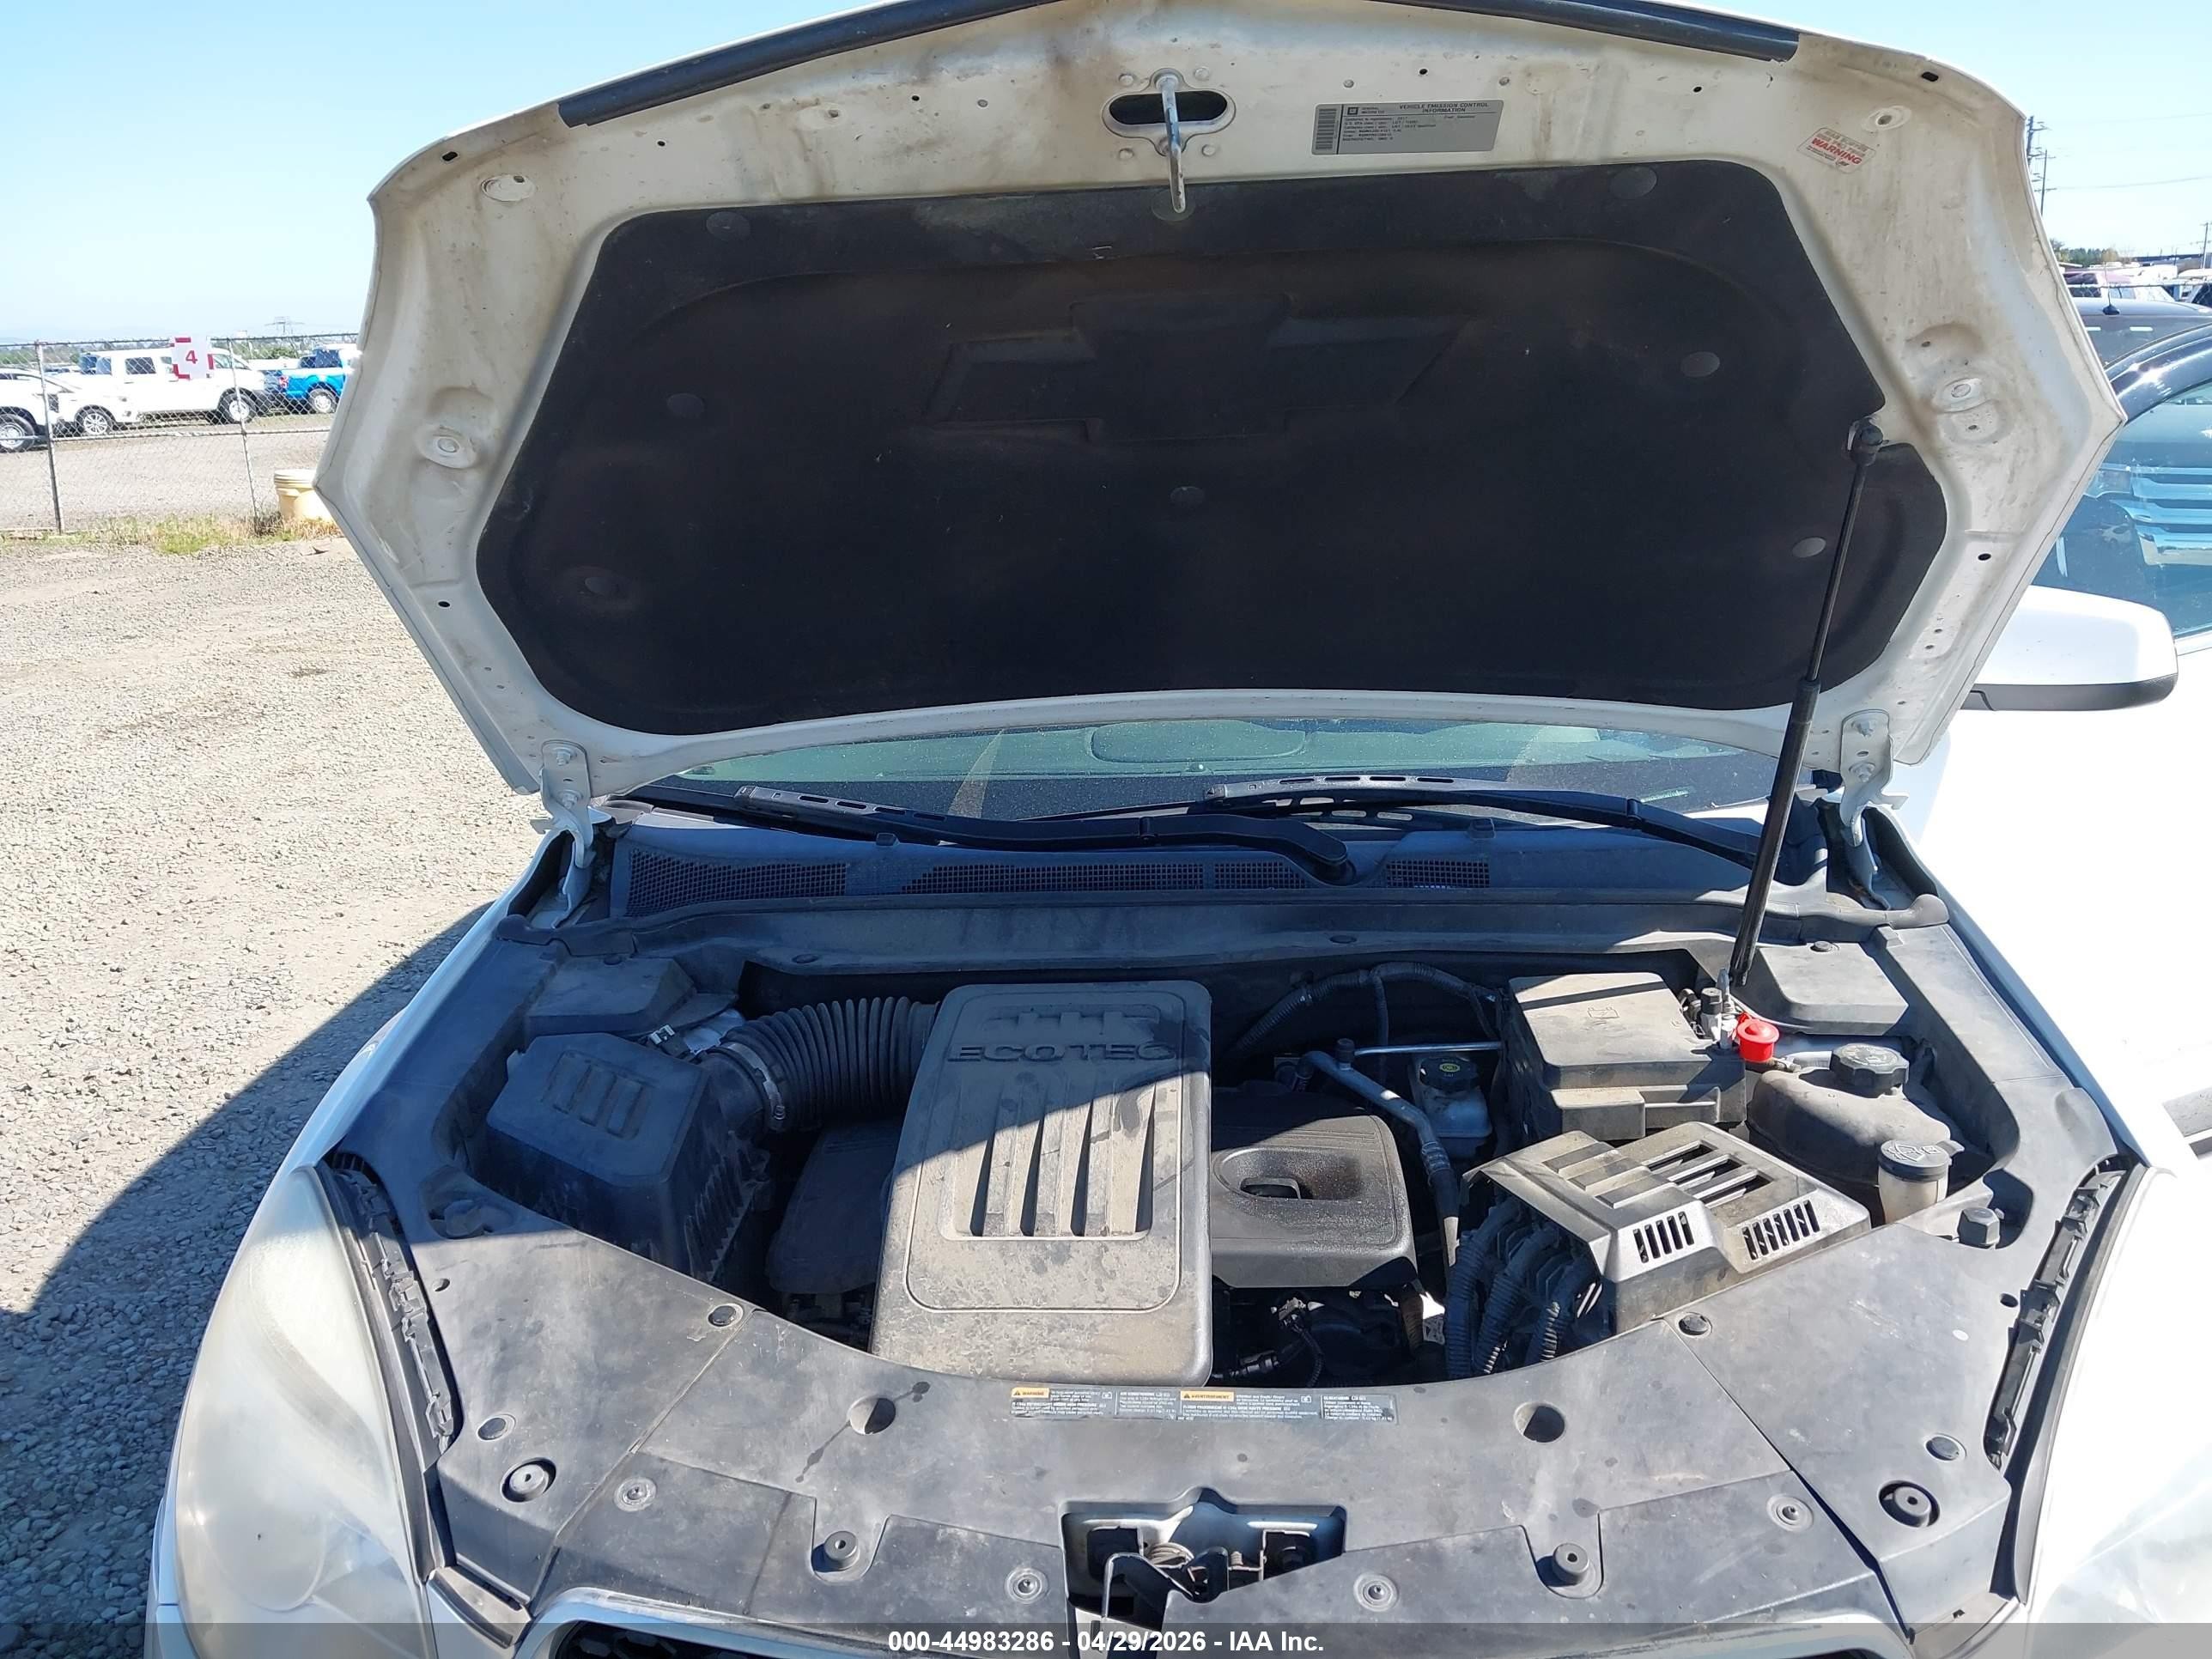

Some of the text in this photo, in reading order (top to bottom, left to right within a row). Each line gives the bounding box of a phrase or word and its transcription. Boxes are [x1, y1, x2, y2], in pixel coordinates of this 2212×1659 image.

[1811, 137, 1863, 165] WARNING
[185, 350, 198, 364] 4
[948, 1043, 1177, 1062] ECOTEC
